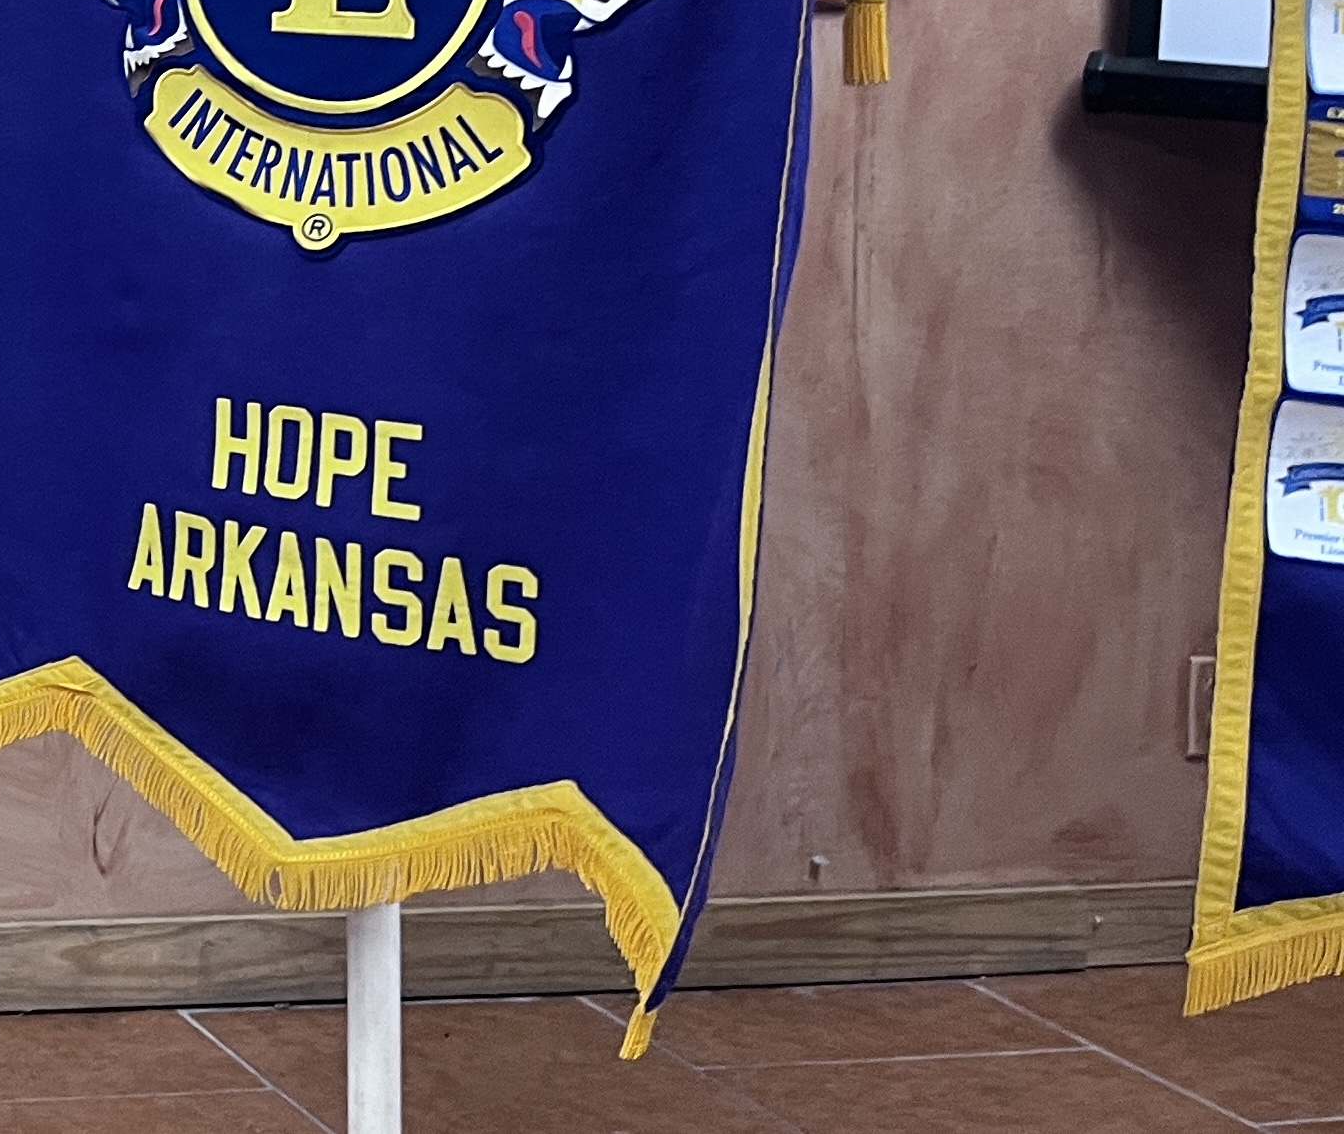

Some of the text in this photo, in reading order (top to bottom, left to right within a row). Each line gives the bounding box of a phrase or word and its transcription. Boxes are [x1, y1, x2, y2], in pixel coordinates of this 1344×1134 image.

[168, 88, 504, 207] INTERNATIONAL
[211, 398, 423, 521] HOPE
[127, 503, 538, 664] ARKANSAS
